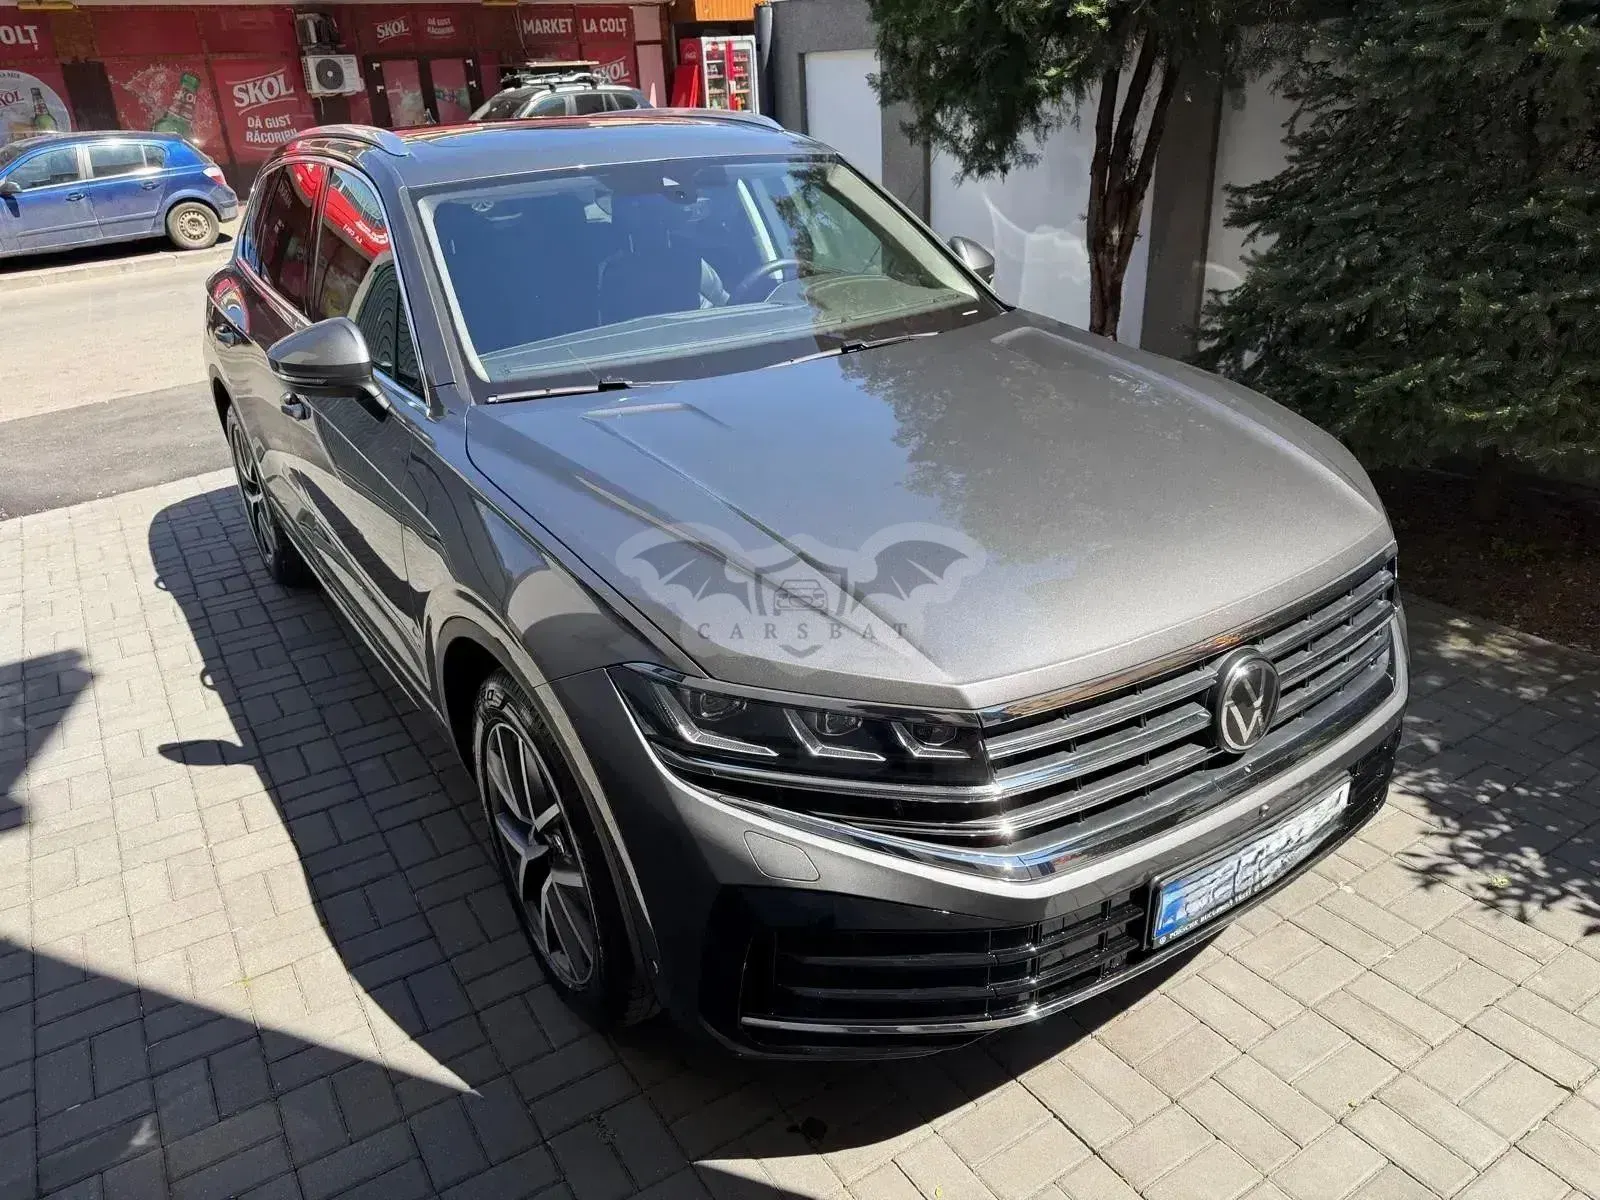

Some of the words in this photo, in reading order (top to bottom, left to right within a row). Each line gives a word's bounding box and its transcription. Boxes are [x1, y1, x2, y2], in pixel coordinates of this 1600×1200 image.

[376, 20, 409, 39] SKOL
[523, 19, 572, 33] MARKET
[582, 18, 598, 32] LA
[600, 18, 627, 37] COLȚ
[233, 74, 295, 107] SKOL
[265, 114, 291, 128] GUST
